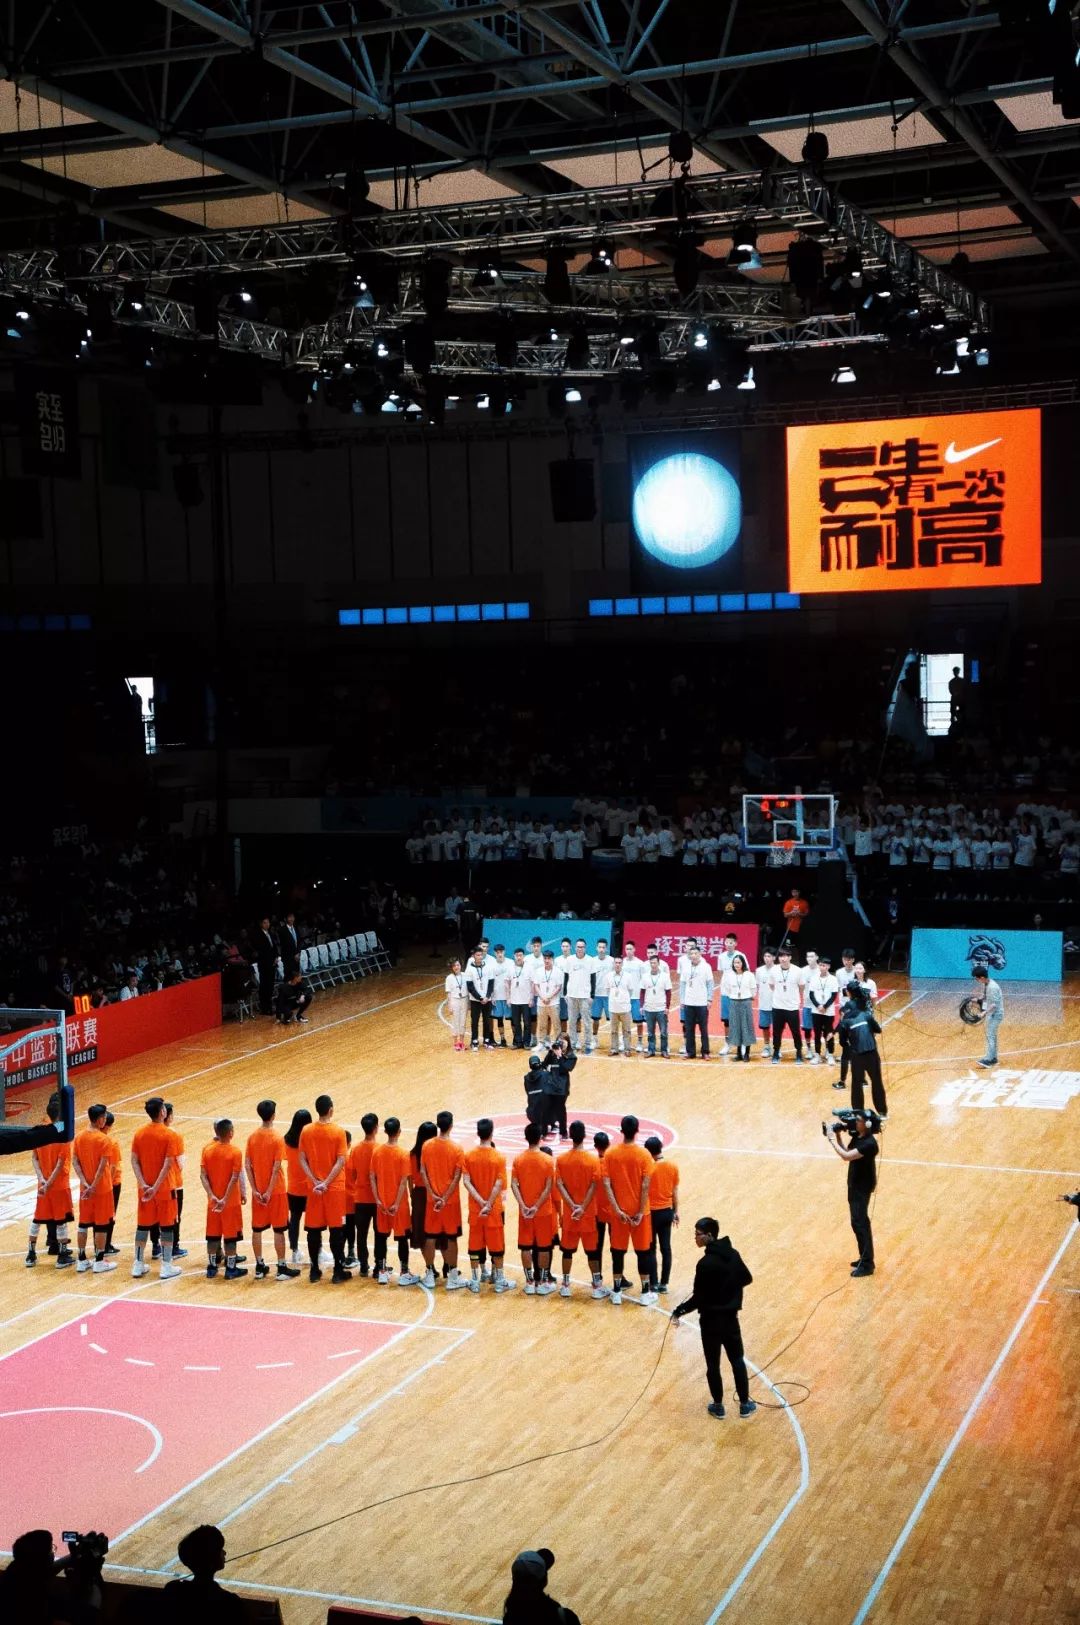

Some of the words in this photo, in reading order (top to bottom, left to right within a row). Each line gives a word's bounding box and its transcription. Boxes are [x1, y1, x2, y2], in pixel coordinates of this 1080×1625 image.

[819, 437, 944, 477] 一生
[819, 468, 1005, 513] 只有一次
[820, 502, 1004, 572] 耐高
[4, 1073, 24, 1087] HOOL
[71, 1050, 95, 1066] LEAGUE
